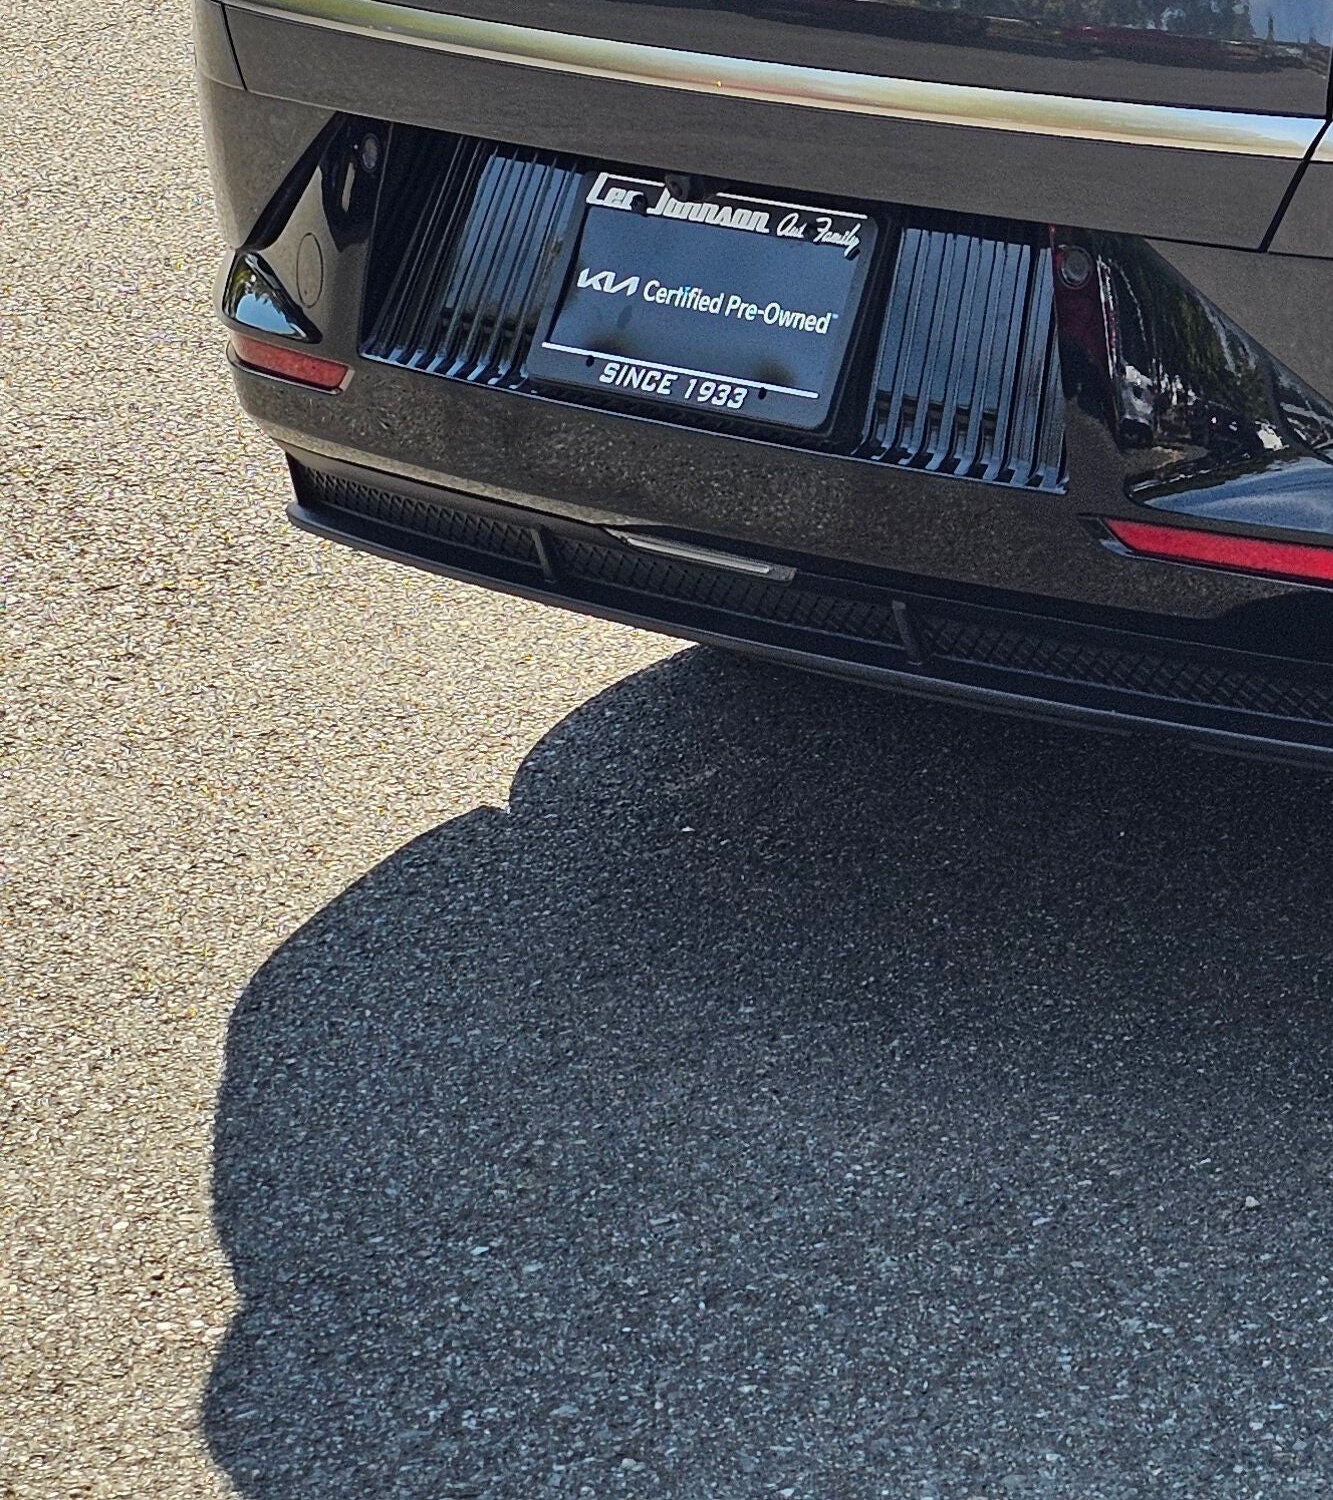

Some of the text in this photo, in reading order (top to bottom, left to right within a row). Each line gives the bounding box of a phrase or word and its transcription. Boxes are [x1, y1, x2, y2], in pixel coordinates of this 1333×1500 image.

[585, 171, 643, 211] Lee
[812, 216, 861, 258] Family
[577, 268, 832, 335] KIA Certified Pre-Owned
[599, 361, 748, 410] SINCE 1933
